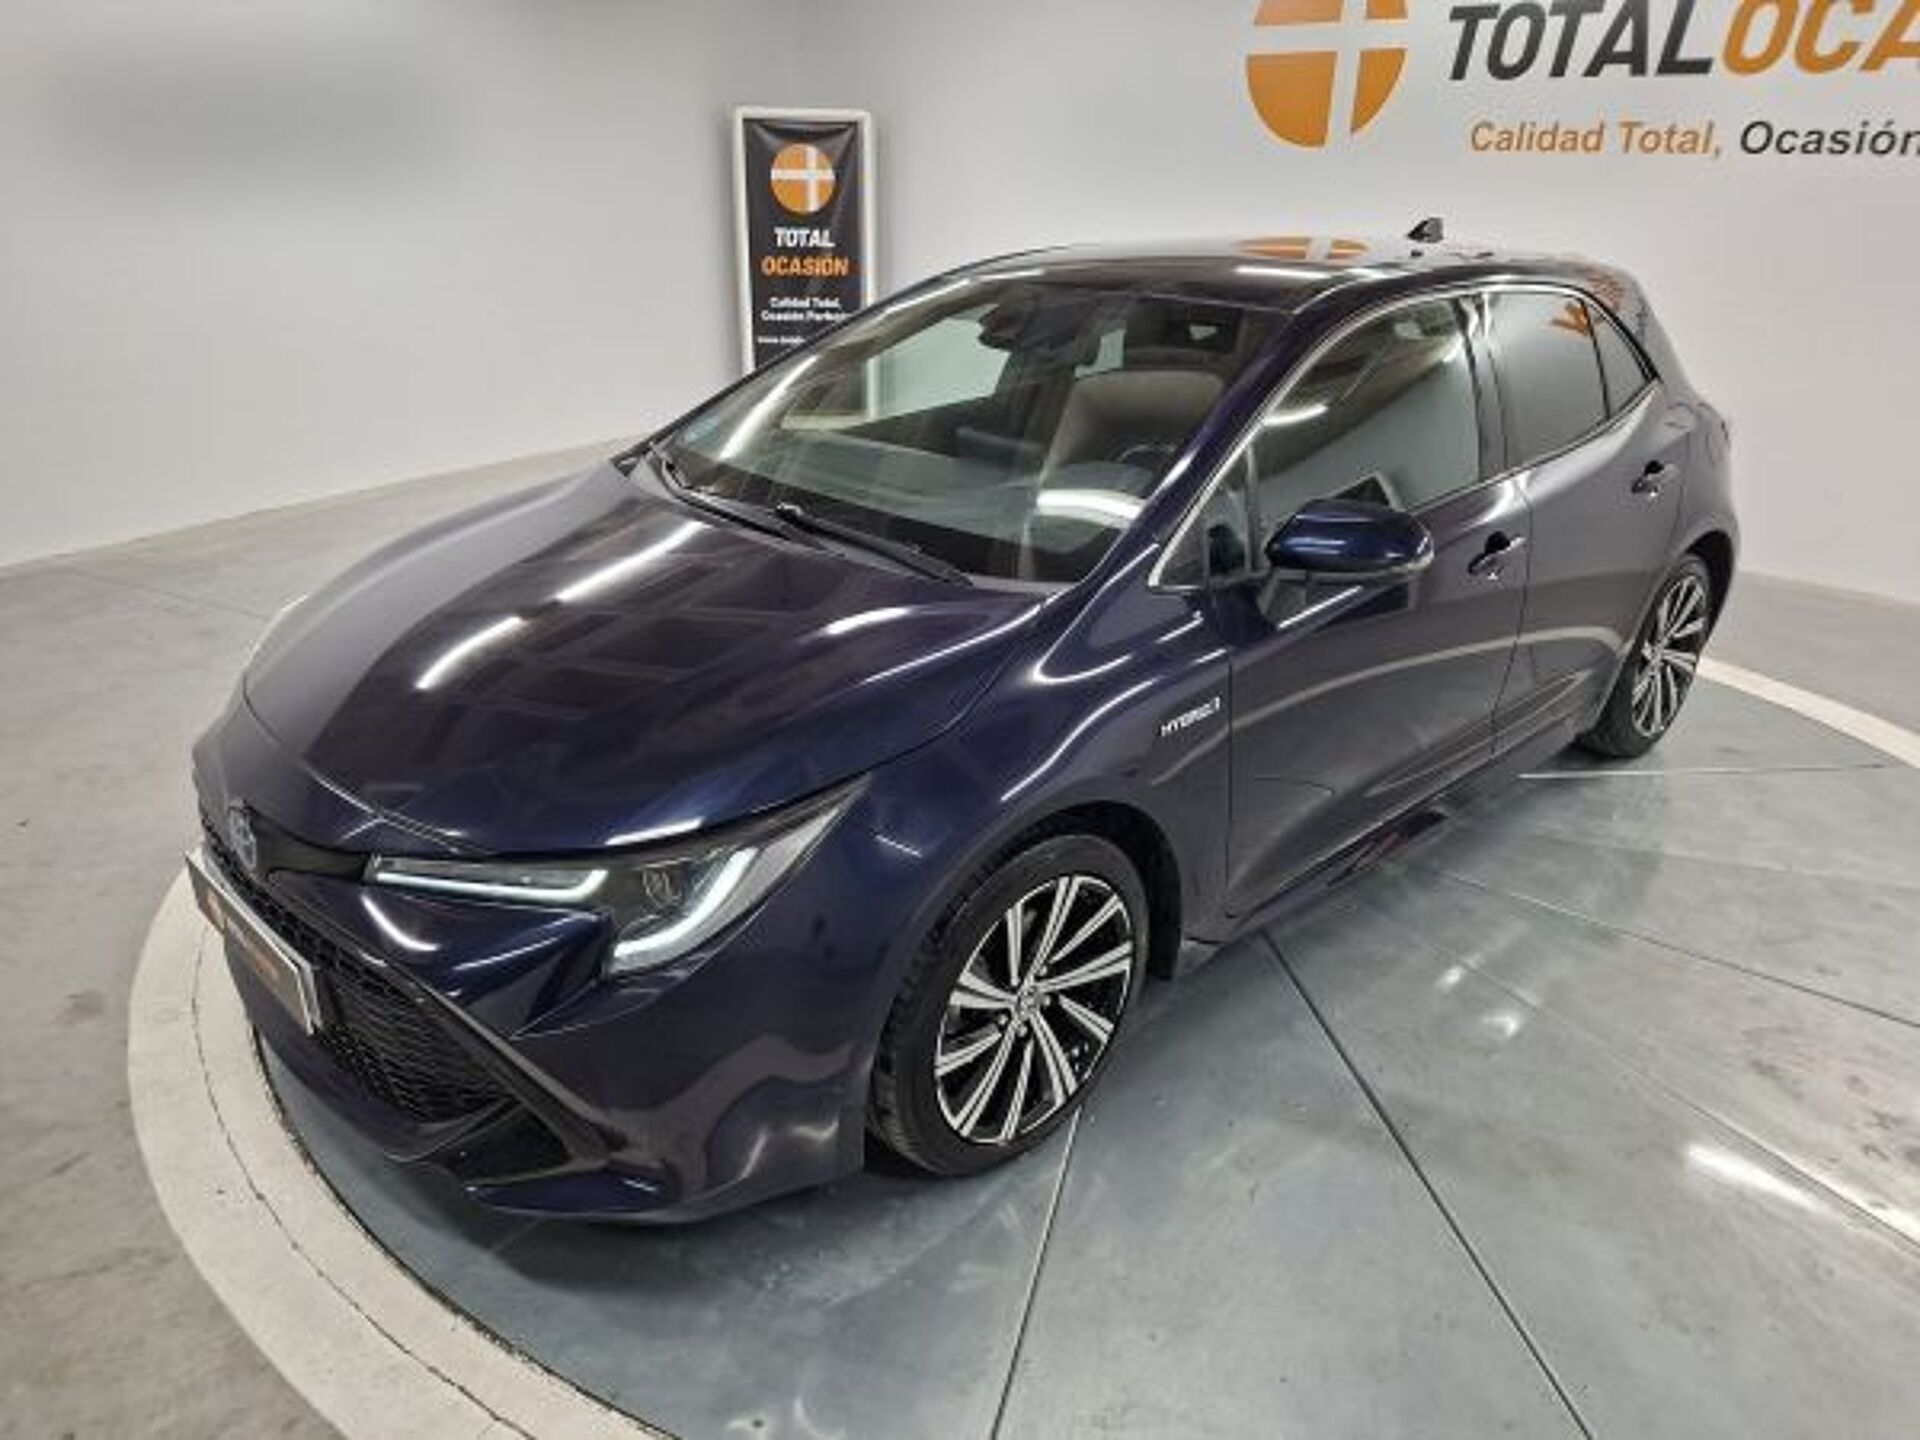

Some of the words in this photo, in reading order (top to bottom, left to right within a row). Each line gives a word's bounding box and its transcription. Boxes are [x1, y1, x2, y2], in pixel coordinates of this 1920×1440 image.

[1470, 119, 1604, 154] Calidad
[1620, 119, 1721, 158] Total,
[1740, 119, 1920, 155] Ocasión
[774, 226, 836, 248] TOTAL
